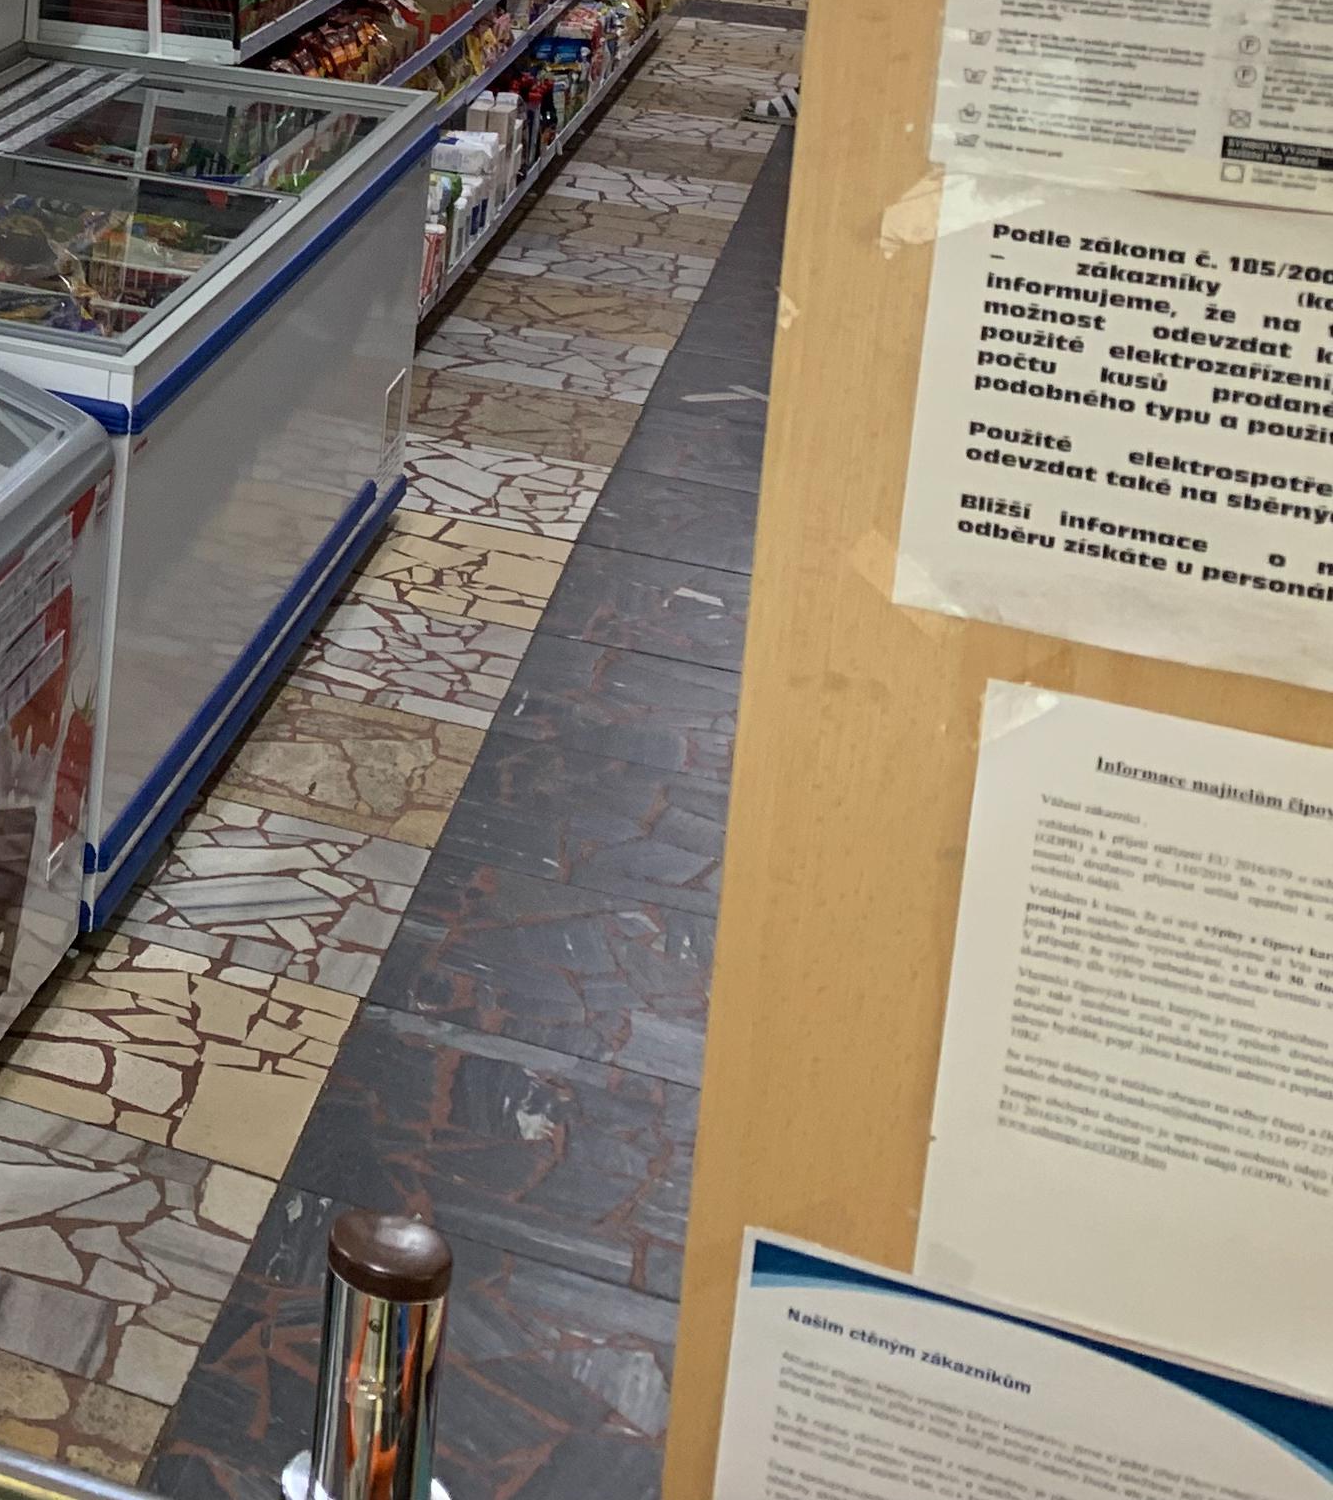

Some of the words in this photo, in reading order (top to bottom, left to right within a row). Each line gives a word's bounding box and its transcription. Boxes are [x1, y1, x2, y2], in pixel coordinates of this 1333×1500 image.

[993, 222, 1071, 248] Podle
[1080, 235, 1186, 265] zákona
[1195, 250, 1218, 269] č.
[986, 272, 1176, 319] informujeme,
[1204, 304, 1237, 324] že
[1262, 314, 1302, 333] na
[1077, 261, 1221, 297] zákazníky
[981, 325, 1085, 353] použité
[984, 300, 1105, 331] možnost
[1152, 325, 1292, 359] odevzdat
[977, 350, 1058, 375] počtu
[1100, 367, 1168, 393] kusů
[975, 374, 1137, 414] podobného
[1145, 400, 1212, 425] typu
[1220, 414, 1238, 430] a
[969, 421, 1072, 453] Použité
[966, 447, 1098, 483] odevzdat
[1106, 470, 1171, 496] také
[1180, 484, 1218, 504] na
[958, 518, 1056, 549] odběru
[1064, 538, 1167, 571] získáte
[1176, 559, 1193, 576] u
[961, 493, 1031, 521] Bližší
[1060, 511, 1208, 553] informace
[1268, 553, 1286, 568] o
[1096, 756, 1187, 788] Informace
[1191, 777, 1284, 809] majitelům
[848, 1328, 916, 1358] ctěným
[920, 1349, 1033, 1395] zákazníkům
